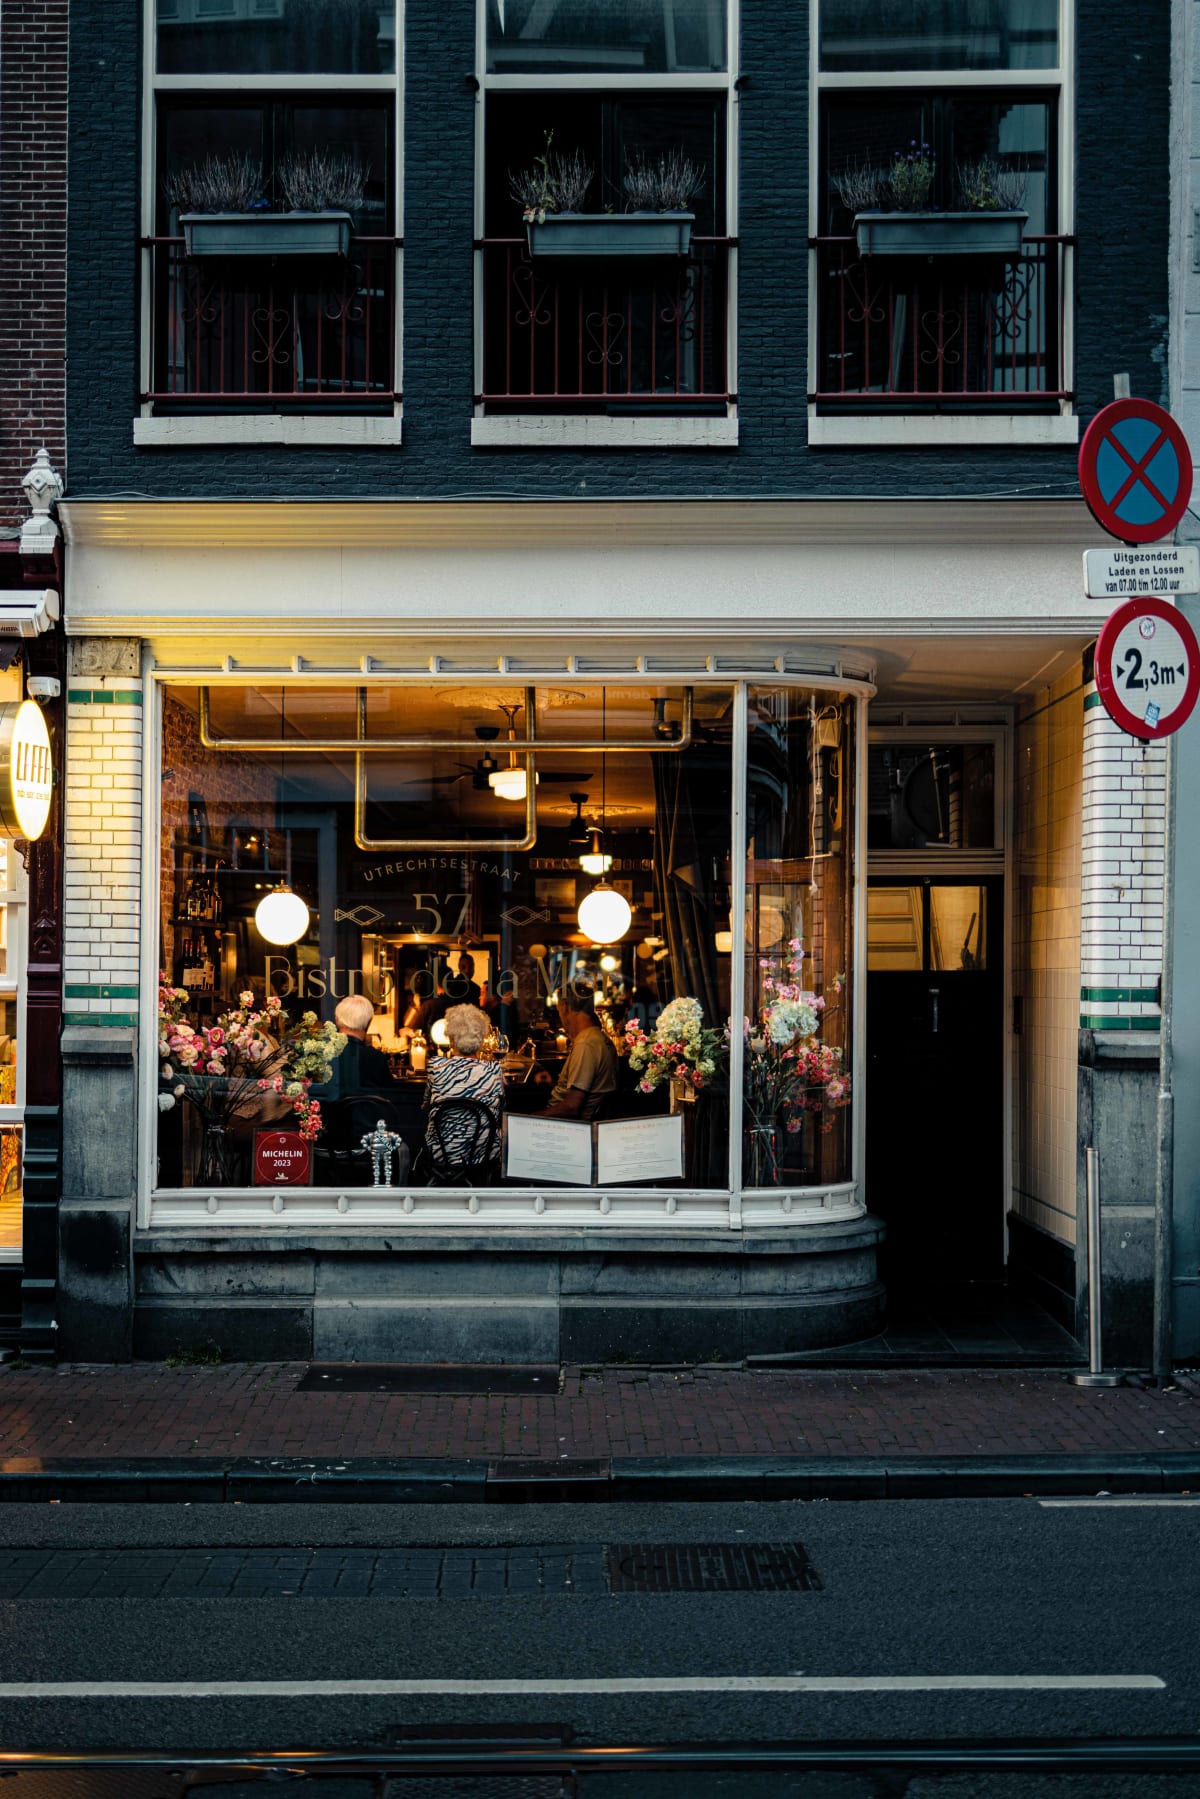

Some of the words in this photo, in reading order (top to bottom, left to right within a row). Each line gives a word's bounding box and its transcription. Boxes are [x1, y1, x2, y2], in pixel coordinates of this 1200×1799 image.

[1113, 551, 1178, 564] Uitgezonderd
[1108, 566, 1136, 577] Laden
[1139, 568, 1150, 576] en
[1153, 565, 1184, 575] Lossen
[1105, 581, 1118, 592] van
[1119, 578, 1137, 592] 07.00
[1150, 577, 1168, 591] 12.00
[1169, 580, 1180, 590] uur
[363, 857, 520, 882] UTRECHTSESTRAAT
[411, 893, 473, 938] 57
[263, 955, 394, 999] Bistro
[409, 956, 470, 999] de
[487, 956, 520, 999] la
[262, 1150, 303, 1158] MICHELIN
[273, 1159, 291, 1167] 2023
